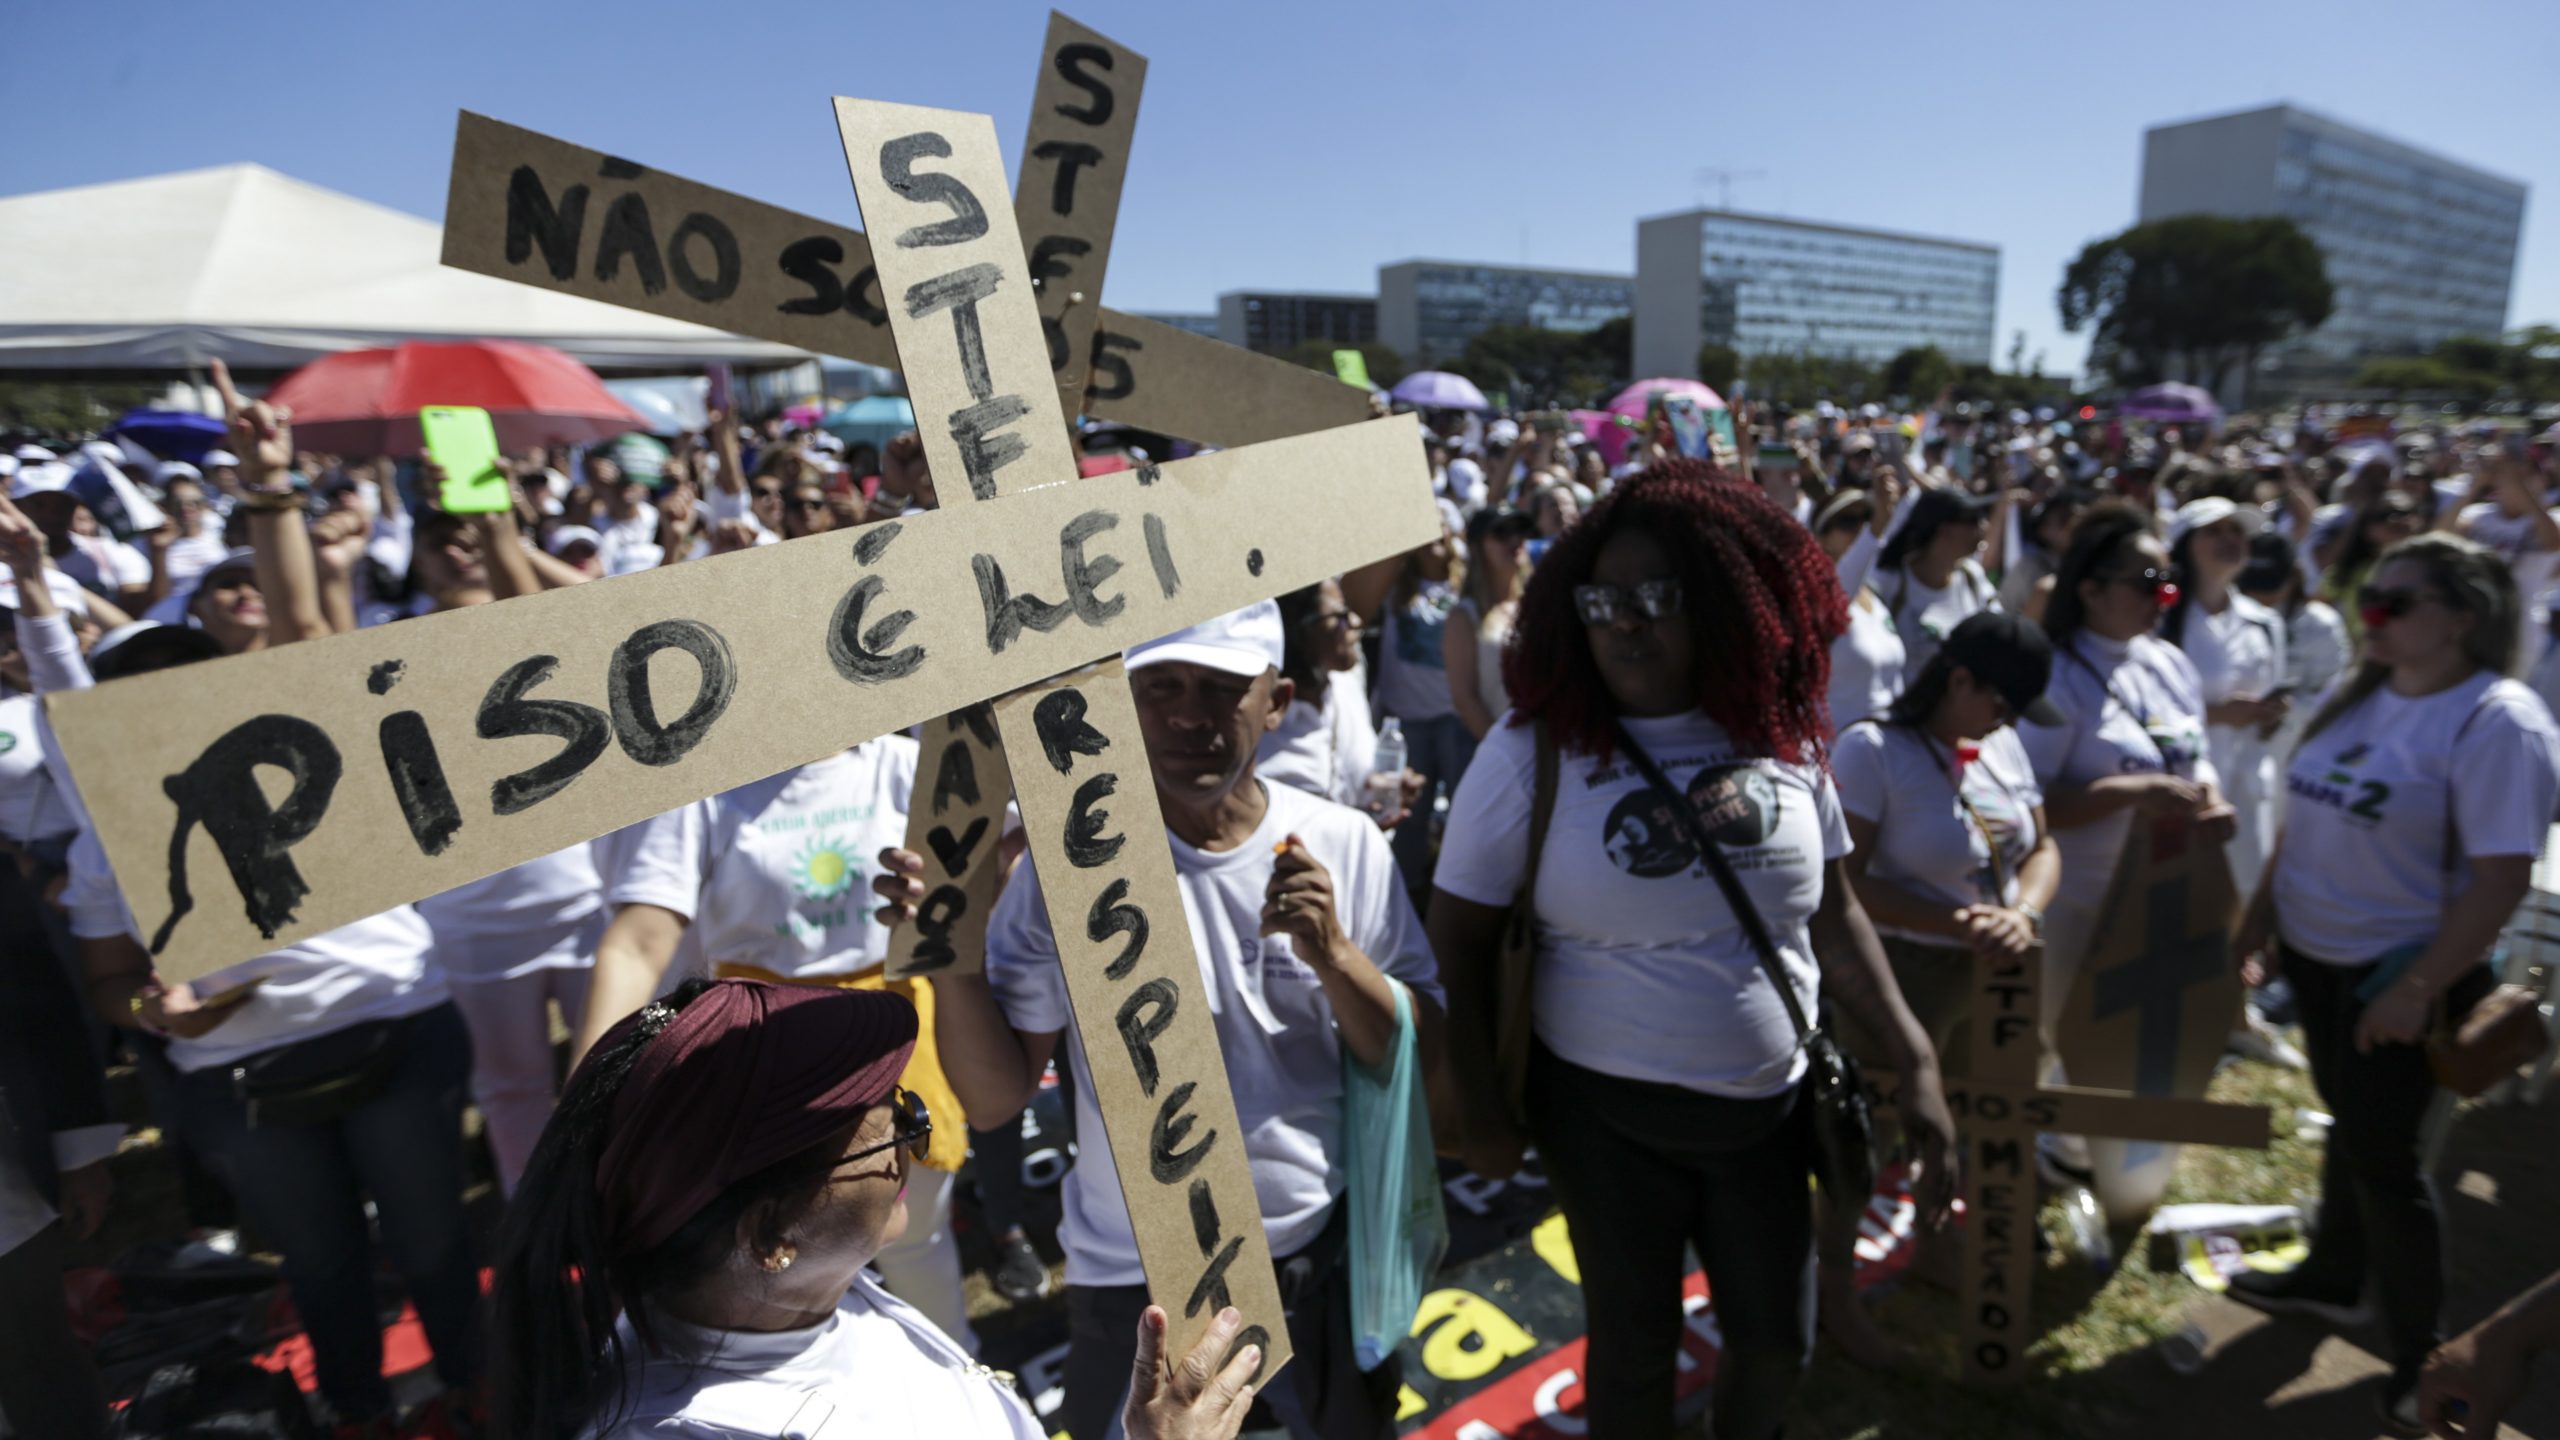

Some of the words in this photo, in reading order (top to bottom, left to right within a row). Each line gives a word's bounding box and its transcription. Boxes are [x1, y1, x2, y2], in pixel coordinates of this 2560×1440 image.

[505, 156, 741, 304] NÃO
[1030, 42, 1115, 298] STF
[879, 131, 1032, 501] STF
[825, 522, 926, 686] É
